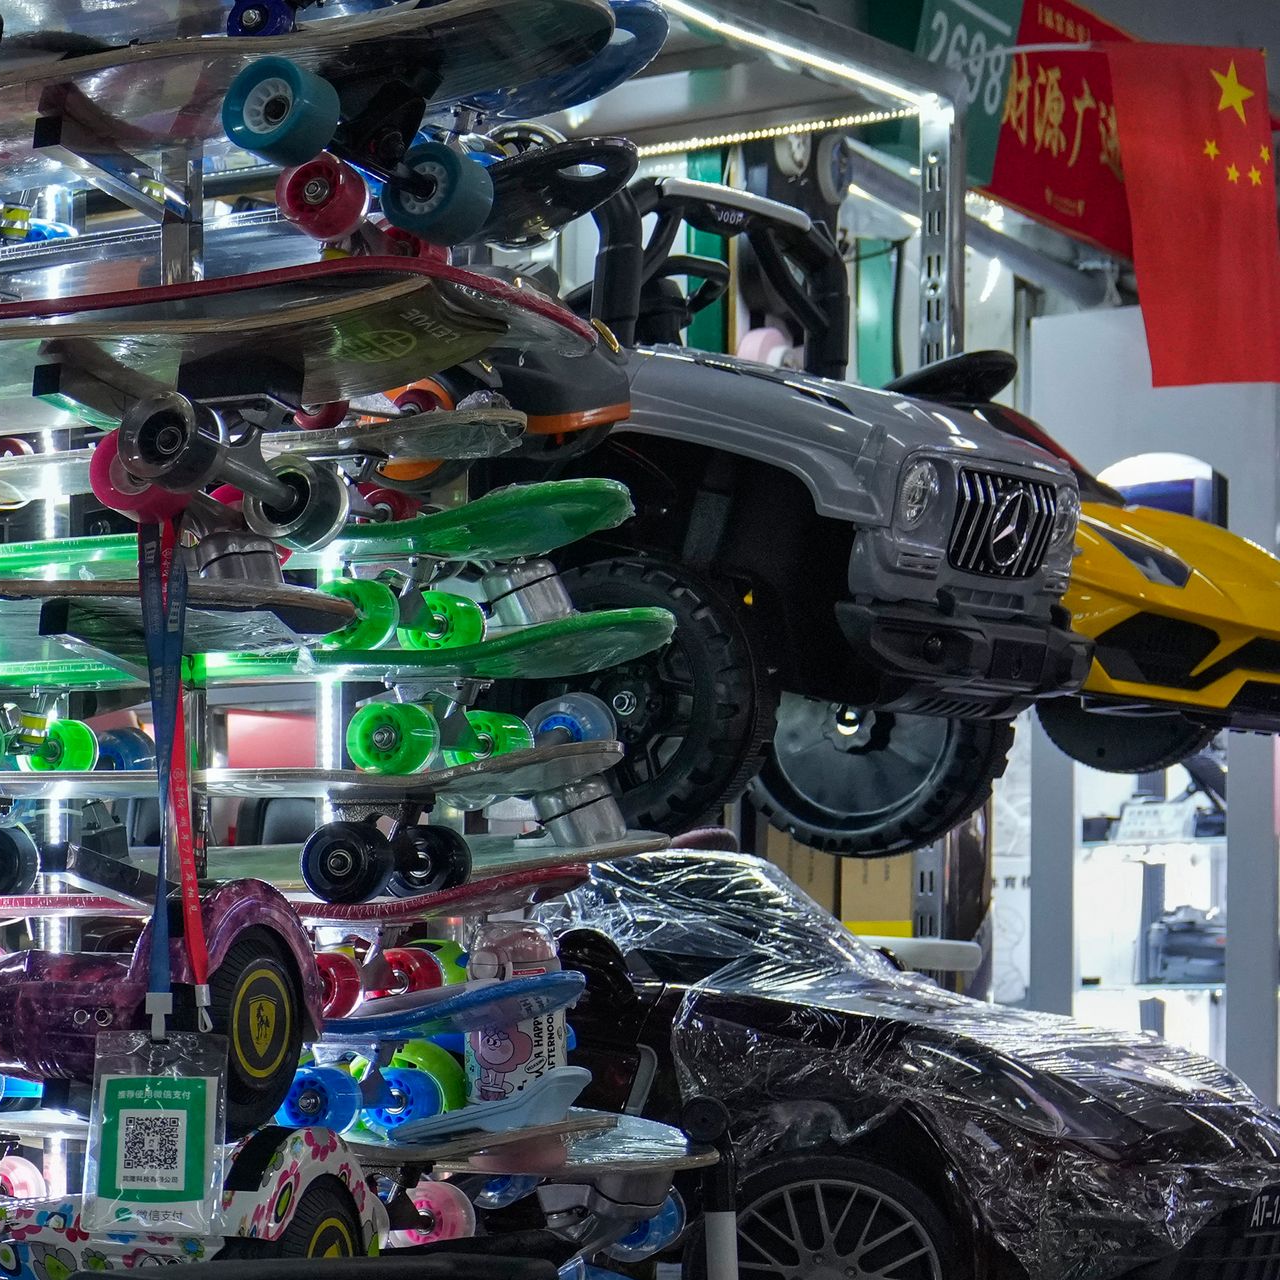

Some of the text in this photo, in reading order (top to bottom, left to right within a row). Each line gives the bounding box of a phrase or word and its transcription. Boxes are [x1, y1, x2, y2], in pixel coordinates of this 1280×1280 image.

[136, 1209, 183, 1222] 微信支付
[1250, 1194, 1280, 1227] AT-1
